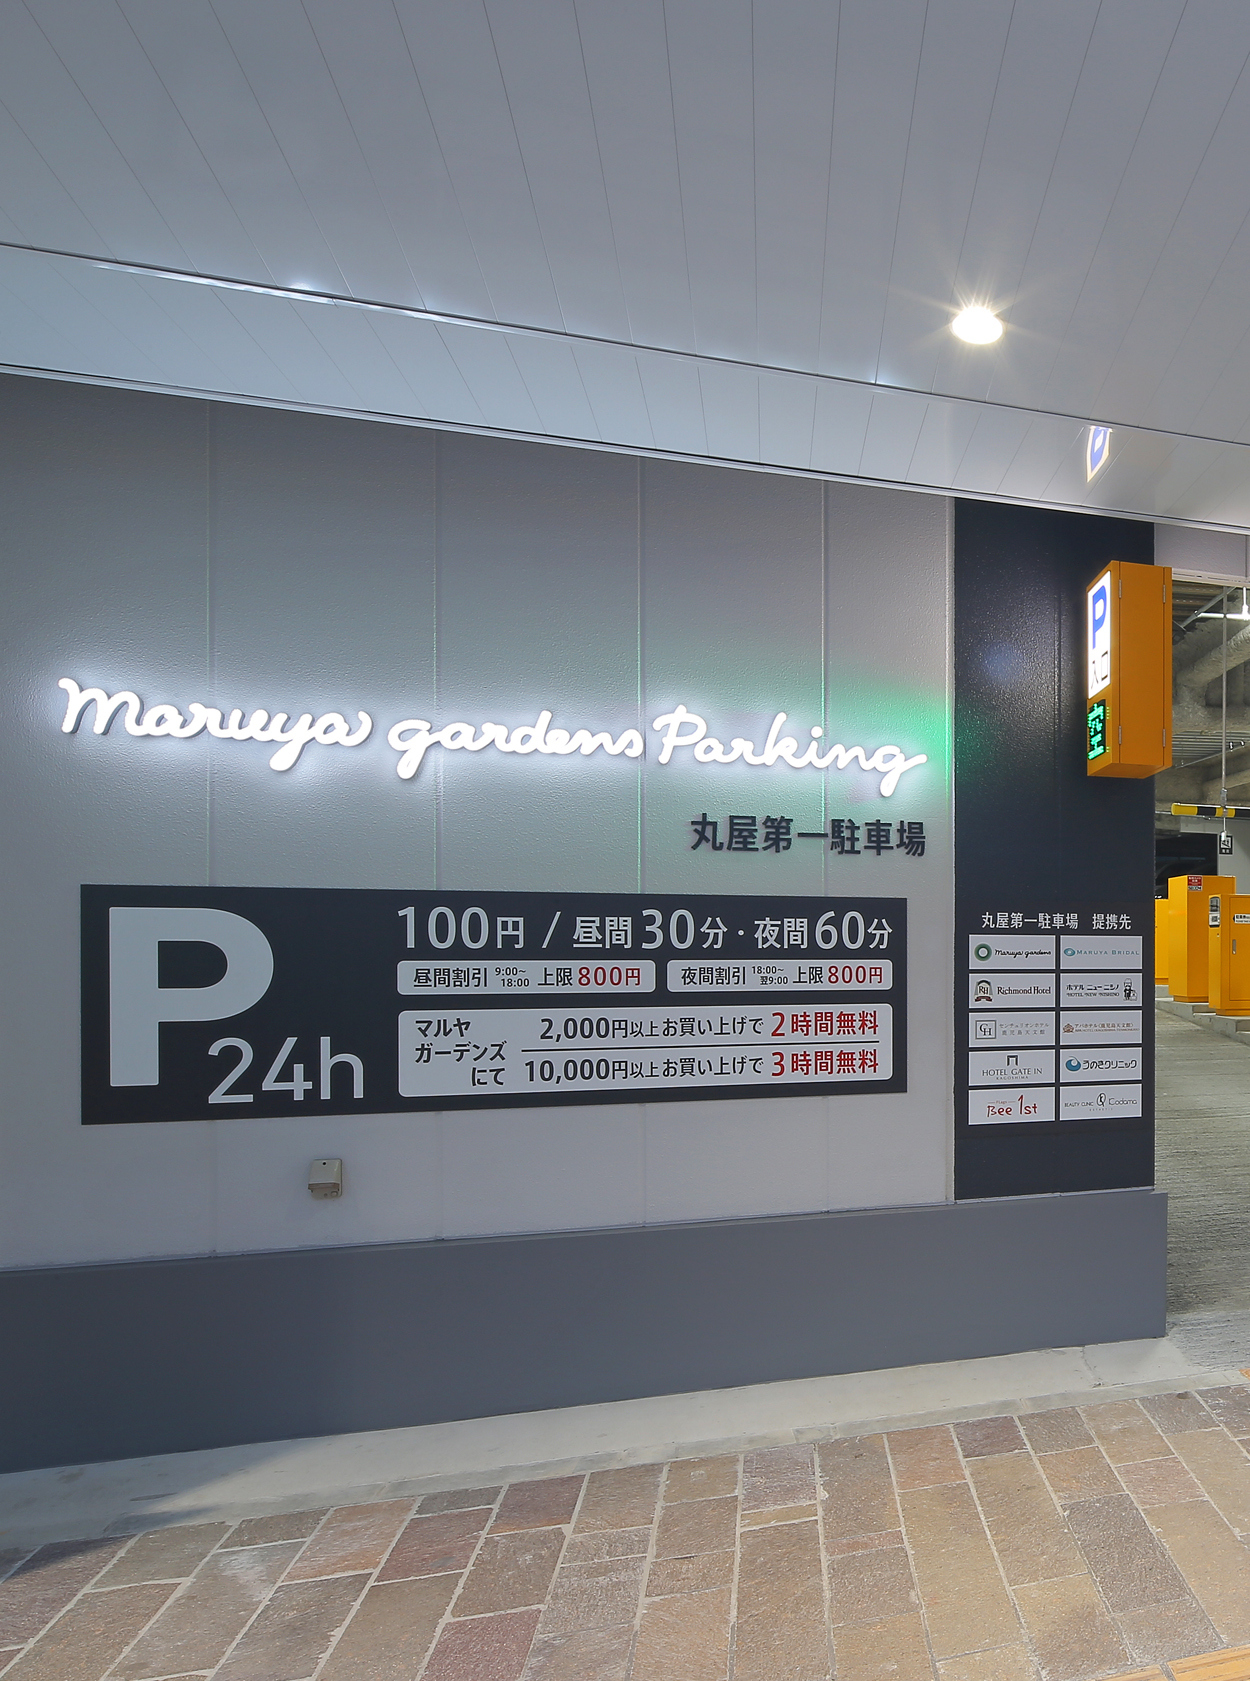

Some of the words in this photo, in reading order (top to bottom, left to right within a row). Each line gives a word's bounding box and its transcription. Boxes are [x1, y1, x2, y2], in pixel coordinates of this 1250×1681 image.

[1092, 585, 1107, 650] P
[1091, 650, 1108, 689] 入口
[58, 677, 373, 771] Maruya
[387, 710, 645, 779] gardens
[652, 704, 927, 797] Parking
[690, 812, 927, 857] 丸屋第一駐車場
[397, 906, 525, 949] 100円
[981, 912, 1079, 929] 丸屋第一駐車場
[1092, 913, 1131, 930] 提携先
[994, 949, 1023, 959] Maruya
[1024, 949, 1052, 959] gardens
[413, 967, 488, 988] 昼間割引
[501, 978, 530, 988] 18:00
[681, 966, 746, 986] 夜間割引
[760, 975, 788, 985] 翌9:00
[109, 906, 274, 1087] P
[997, 986, 1032, 995] Richmond
[1033, 986, 1051, 995] Hotel
[415, 1018, 471, 1038] マルヤ
[415, 1040, 507, 1064] ガーデンズ
[208, 1036, 364, 1104] 24h
[471, 1066, 506, 1087] にて
[986, 1105, 1013, 1117] Bee
[1017, 1095, 1038, 1115] 1st
